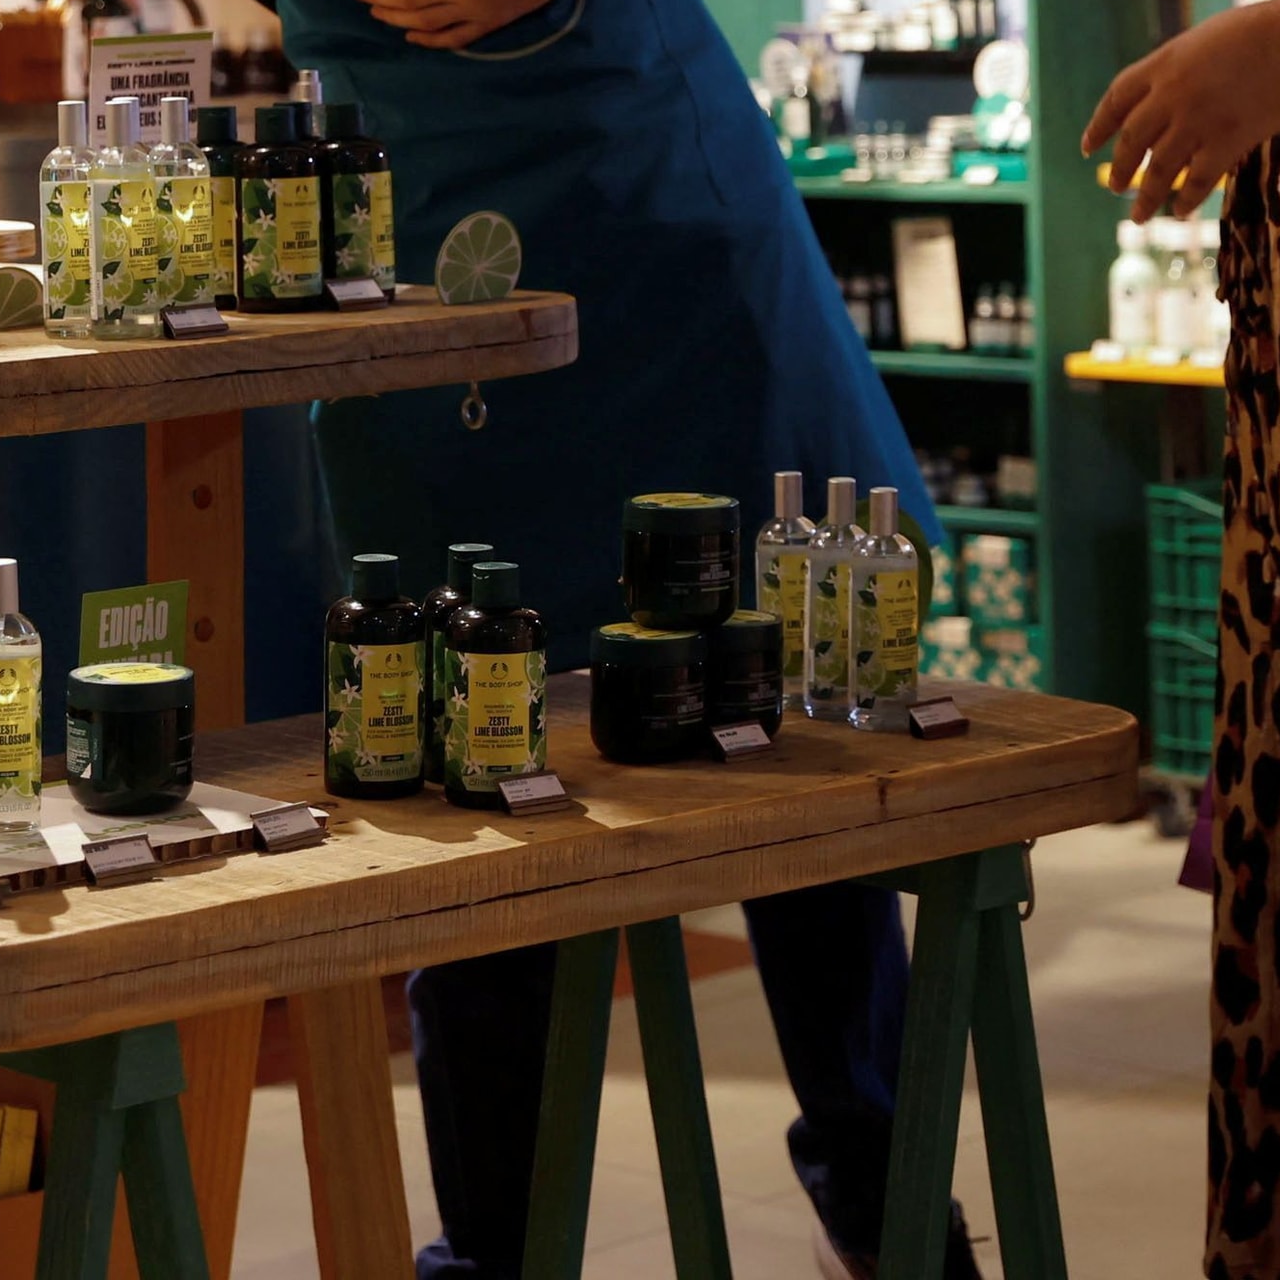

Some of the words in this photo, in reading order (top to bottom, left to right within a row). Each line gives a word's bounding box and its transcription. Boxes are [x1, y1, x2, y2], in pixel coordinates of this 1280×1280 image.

[111, 75, 130, 91] UMA
[133, 70, 190, 89] FRAGRÂNCIA
[139, 111, 156, 127] EUS
[70, 248, 85, 257] LIME
[129, 248, 144, 257] LIME
[180, 244, 195, 253] LIME
[98, 597, 168, 651] EDIÇÃO
[383, 705, 403, 716] ZESTY
[368, 716, 384, 727] LIME
[386, 715, 414, 726] BLOSSOM
[489, 716, 510, 726] ZESTY
[474, 726, 490, 736] LIME
[491, 726, 523, 736] BLOSSOM
[0, 733, 31, 745] BLOSSOM
